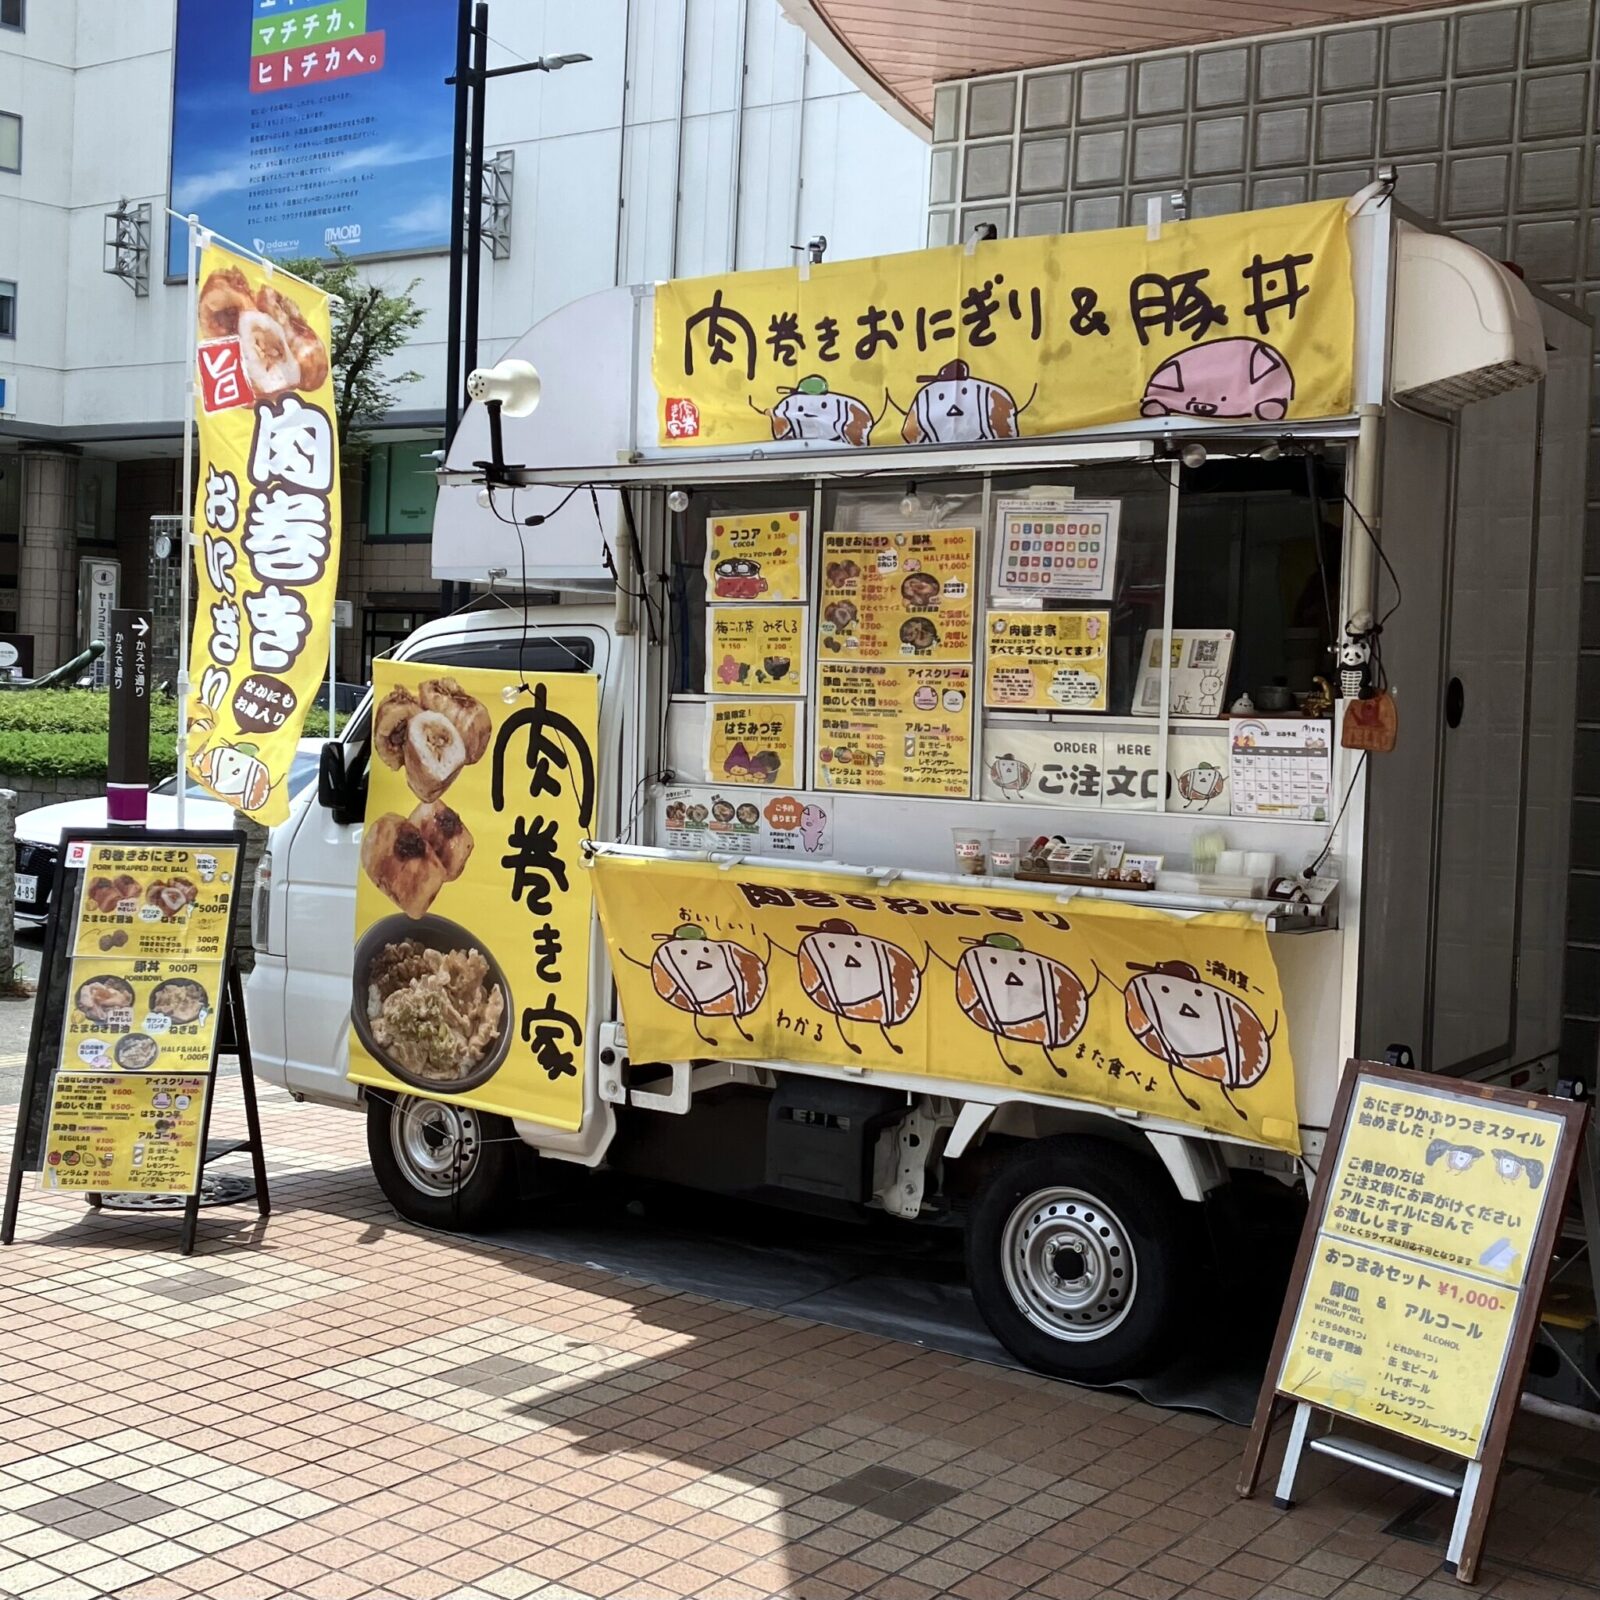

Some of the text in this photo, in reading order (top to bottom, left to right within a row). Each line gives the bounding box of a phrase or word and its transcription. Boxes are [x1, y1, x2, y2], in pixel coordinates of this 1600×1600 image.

[259, 8, 355, 45] マチチカ、
[259, 46, 377, 83] ヒトチカへ。
[684, 253, 1314, 381] 肉巻きおにぎり & 豚丼
[244, 394, 333, 671] 肉巻き
[730, 528, 761, 541] ココア
[200, 464, 239, 711] おにぎり
[763, 619, 797, 634] みぞしる
[114, 632, 124, 690] かえで通り
[990, 645, 1102, 656] すべて手づくりしてます！
[135, 639, 147, 698] かえで通り
[908, 669, 969, 678] アイスクリーム
[243, 679, 295, 709] なかにも
[724, 722, 783, 735] はちみつ芋
[905, 723, 951, 732] アルコール
[1054, 742, 1151, 755] ORDER HERE
[99, 849, 189, 862] 肉巻きおにぎり
[115, 864, 149, 872] WRAPPED
[492, 682, 595, 1081] 肉巻き家
[199, 904, 228, 914] 500円
[169, 964, 198, 974] 900円
[70, 1023, 130, 1034] たまねぎ醤油
[776, 1008, 823, 1042] わかる
[145, 1078, 200, 1086] アイスクリーム
[1075, 1043, 1158, 1092] また食べよ
[1358, 1111, 1435, 1140] 始めました！
[1362, 1096, 1546, 1147] おにぎりかぶりつきスタイル
[1348, 1156, 1425, 1186] ご希望の方は
[1339, 1188, 1474, 1235] アルミホイルに包んで
[1343, 1173, 1522, 1228] ご注文時にお声がけください
[1333, 1205, 1413, 1236] お渡しします
[1325, 1248, 1506, 1311] おつまみセット ¥1,000-
[1314, 1303, 1365, 1325] WITHOUT RICE
[1321, 1297, 1362, 1315] PORK BOWL
[1376, 1296, 1386, 1310] &
[1404, 1303, 1483, 1340] アルコール
[1423, 1333, 1460, 1350] ALCOHOL
[1384, 1372, 1430, 1394] ハイボール
[1401, 1360, 1439, 1380] 生ビール
[1380, 1387, 1435, 1410] レモンサワー
[1376, 1402, 1477, 1442] グレープフルーツサワー
